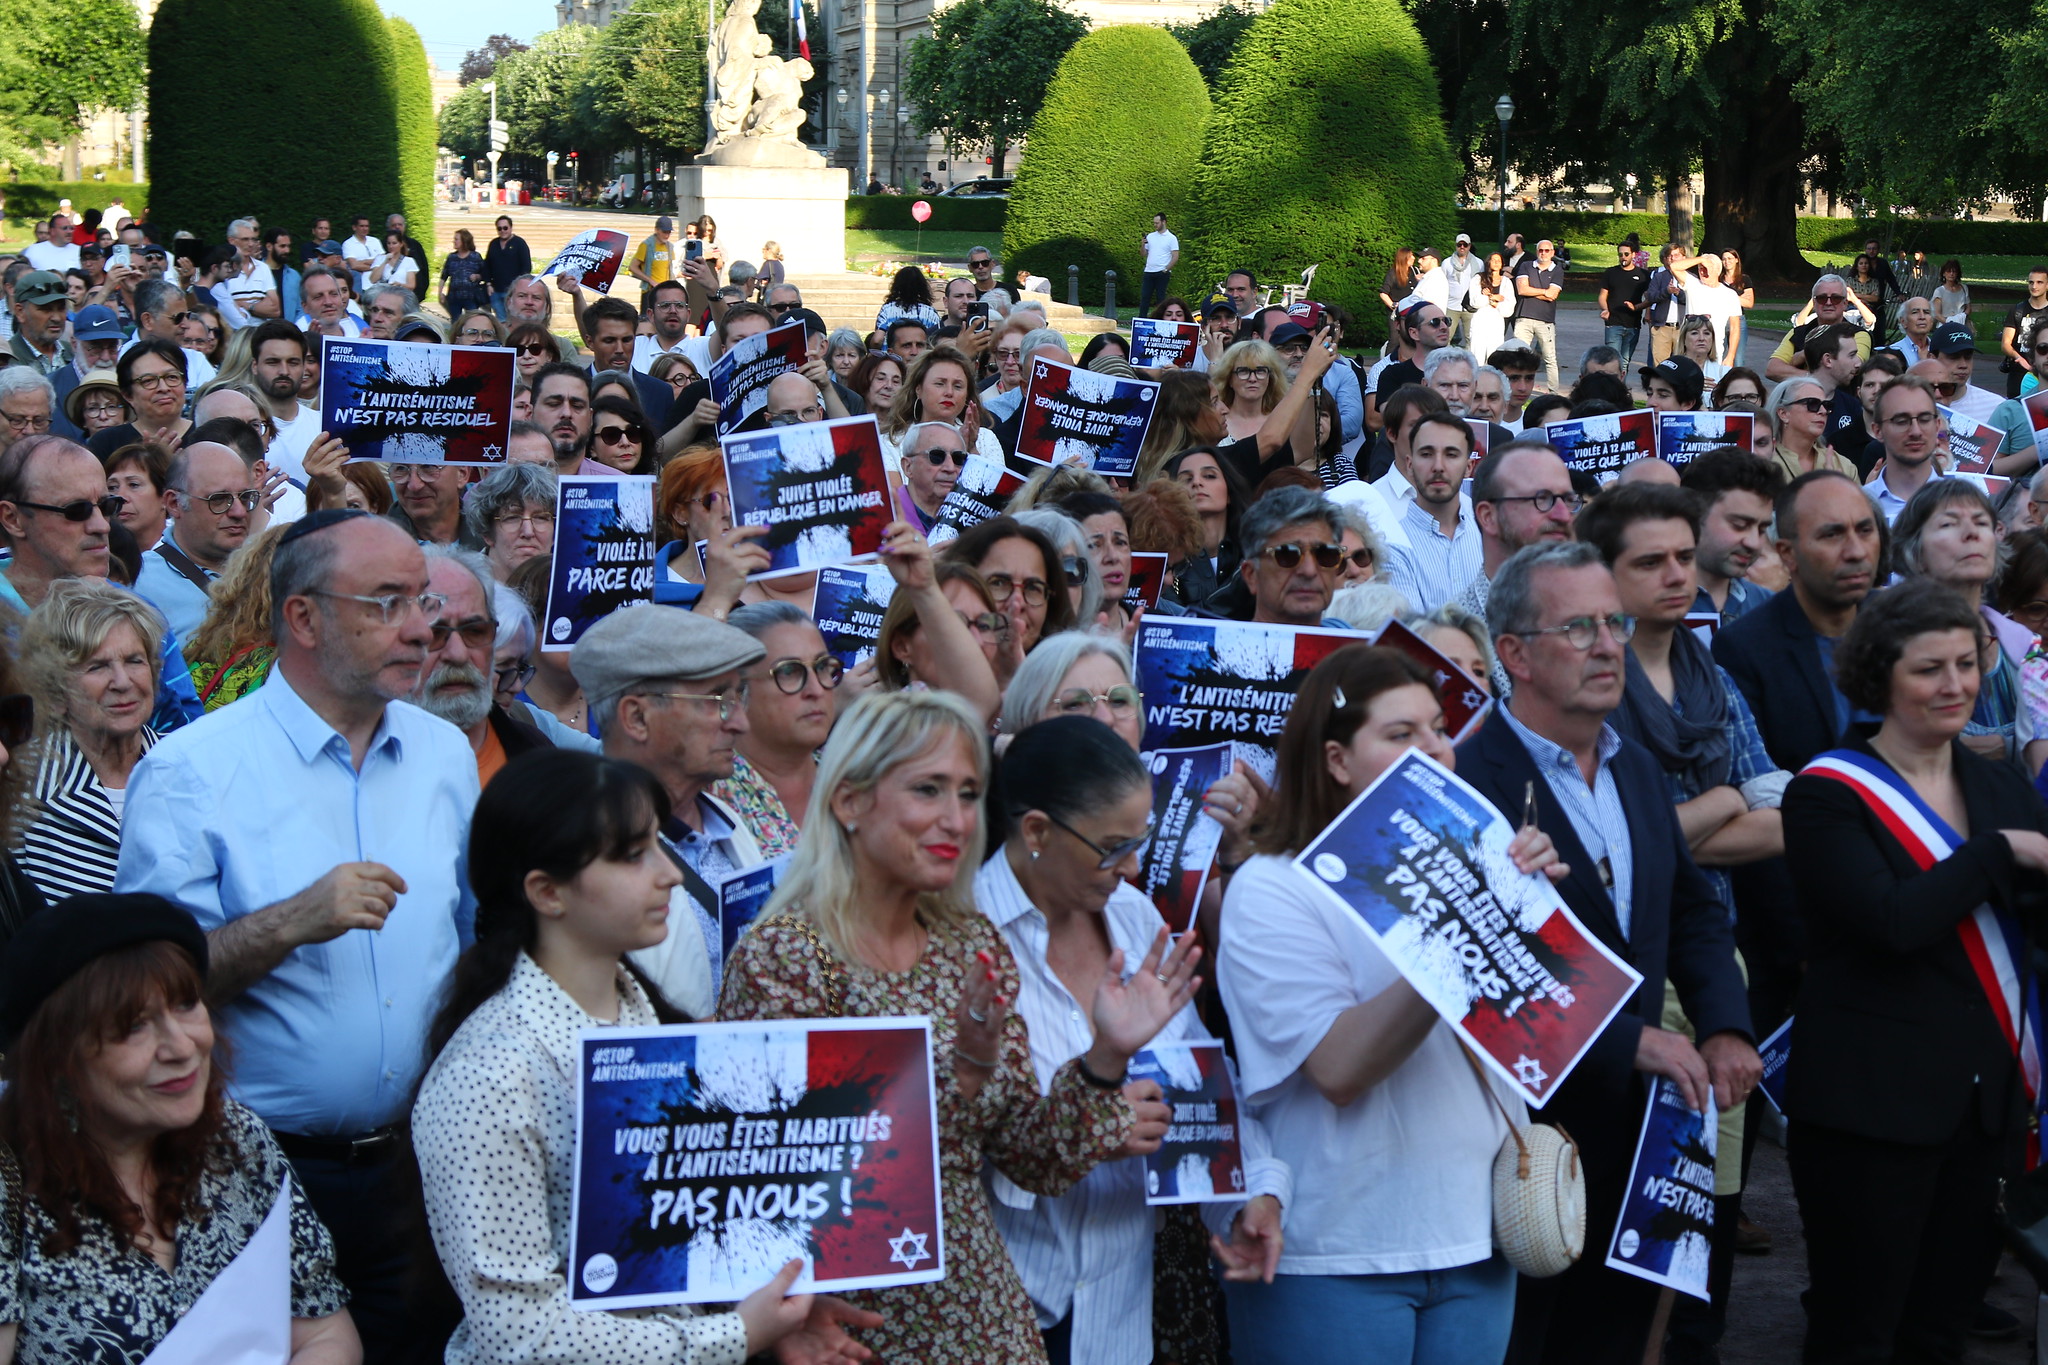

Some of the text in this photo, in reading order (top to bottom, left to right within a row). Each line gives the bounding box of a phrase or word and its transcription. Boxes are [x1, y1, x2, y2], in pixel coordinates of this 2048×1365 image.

[567, 255, 595, 270] NOUS
[594, 262, 600, 273] !
[330, 346, 353, 355] #STOP
[330, 354, 382, 365] ANTISÉMITISME
[1145, 348, 1158, 356] PAS
[1160, 349, 1179, 358] NOUS
[360, 391, 476, 410] L'ANTISÉMITISME
[720, 391, 738, 411] N'EST
[739, 377, 754, 395] PAS
[335, 407, 497, 427] N'EST PAS RÉSIDUEL
[1034, 393, 1144, 428] RÉPUBLIQUE EN DANGER
[1050, 413, 1114, 437] JUIVE VIOLÉE
[1574, 440, 1636, 458] VIOLÉE À 12 ANS
[1667, 452, 1695, 463] N'EST
[1598, 454, 1620, 469] QUE
[565, 488, 588, 498] #STOP
[777, 473, 853, 505] JUIVE VIOLÉE
[565, 497, 613, 509] ANTISÉMITISME
[743, 491, 885, 527] RÉPUBLIQUE EN DANGER
[596, 537, 637, 562] VIOLÉE
[637, 537, 645, 560] À
[567, 566, 653, 593] PARCE QUE
[818, 617, 881, 639] RÉPUBLIQUE
[851, 611, 884, 626] JUIVE
[1144, 626, 1173, 638] #STOP
[1143, 637, 1208, 651] ANTISÉMITISME
[1149, 704, 1210, 730] N'EST
[1210, 709, 1251, 733] PAS
[1409, 763, 1447, 788] #STOP
[1402, 770, 1479, 830] ANTISÉMITISME
[1152, 840, 1166, 861] EN
[1157, 796, 1193, 887] JUIVE VIOLÉE
[1389, 808, 1576, 1009] VOUS VOUS ÊTES HABITUÉS
[1385, 863, 1526, 1018] PAS NOUS !
[1419, 855, 1533, 992] L'ANTISÉMITISME
[1528, 988, 1545, 1003] ?
[592, 1047, 635, 1065] #STOP
[592, 1061, 688, 1082] ANTISÉMITISME
[614, 1109, 892, 1154] VOUS VOUS ÊTES HABITUÉS
[644, 1144, 864, 1182] À L'ANTISÉMITISME ?
[650, 1176, 853, 1231] PAS NOUS !
[1643, 1175, 1688, 1213] N'EST
[1683, 1189, 1708, 1221] PAS
